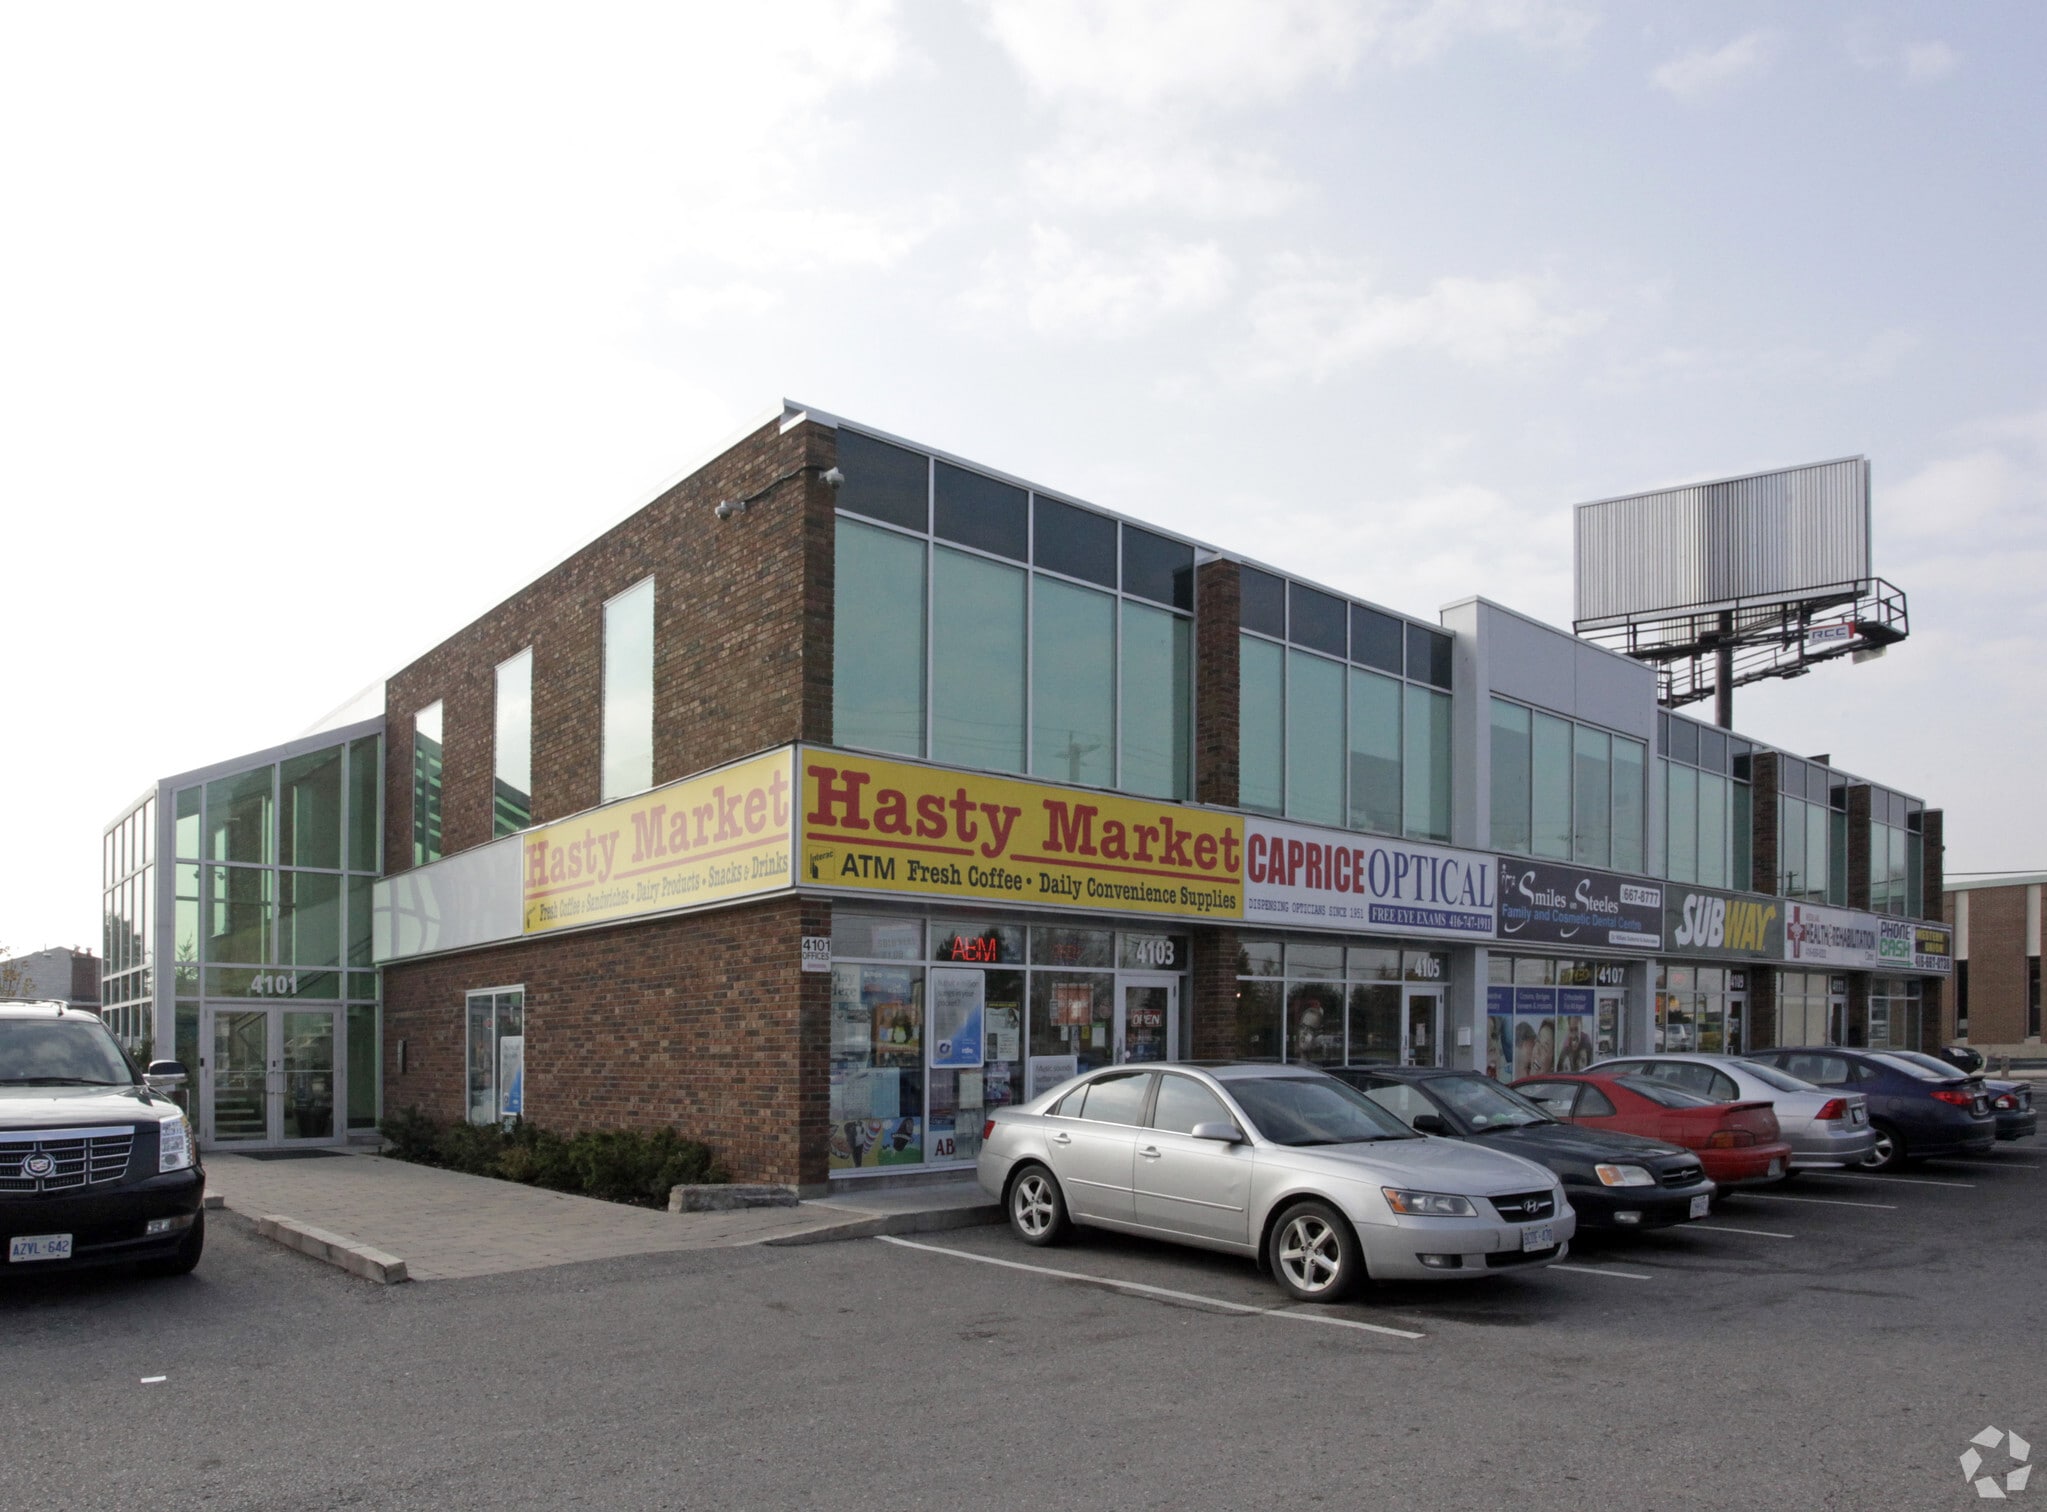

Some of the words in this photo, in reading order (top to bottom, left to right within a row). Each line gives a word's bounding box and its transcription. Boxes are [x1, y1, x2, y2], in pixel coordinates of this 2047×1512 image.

[1812, 627, 1846, 639] RCC
[525, 828, 620, 889] Hasty
[630, 769, 790, 863] Market
[807, 765, 1022, 859] Hasty
[1042, 798, 1240, 873] Market
[1248, 833, 1365, 894] CAPRICE
[1368, 848, 1494, 909] OPTICAL
[539, 902, 558, 921] Fresh
[559, 895, 580, 917] Coffee
[586, 886, 629, 912] Sandwiches
[636, 880, 660, 904] Dairy
[661, 872, 700, 898] Products
[708, 861, 742, 888] Snacks
[751, 850, 788, 879] Drinks
[840, 852, 896, 881] ATM
[906, 859, 962, 886] Fresh
[967, 866, 1022, 891] Coffee
[1039, 873, 1082, 900] Daily
[1086, 876, 1176, 905] Convenience
[1179, 887, 1236, 913] Supplies
[1518, 870, 1567, 908] Smiles
[1574, 878, 1619, 914] Steeles
[1248, 898, 1289, 912] DISPENSING
[1292, 902, 1326, 915] OPTICIANS
[1328, 906, 1347, 918] SINCE
[1372, 906, 1395, 922] FREE
[1397, 909, 1416, 924] EYE
[1416, 911, 1446, 927] EXAMS
[1449, 914, 1491, 931] 416-747-1911
[1502, 902, 1532, 923] Family
[1534, 910, 1550, 920] and
[1552, 910, 1590, 926] Cosmetic
[1592, 915, 1616, 928] Dental
[1618, 918, 1642, 931] Centre
[1675, 893, 1777, 951] SUBWAY
[1881, 921, 1910, 940] PHONE
[1805, 922, 1829, 945] HEALTH
[803, 939, 830, 951] 4101
[1136, 940, 1175, 965] 4103
[1880, 938, 1910, 957] CASH
[803, 952, 830, 961] OFFICES
[1415, 958, 1440, 978] 4105
[1600, 968, 1624, 984] 4107
[251, 975, 298, 994] 4101
[1132, 1014, 1160, 1025] OPEN
[12, 1242, 41, 1256] AZVL
[49, 1240, 69, 1254] 642
